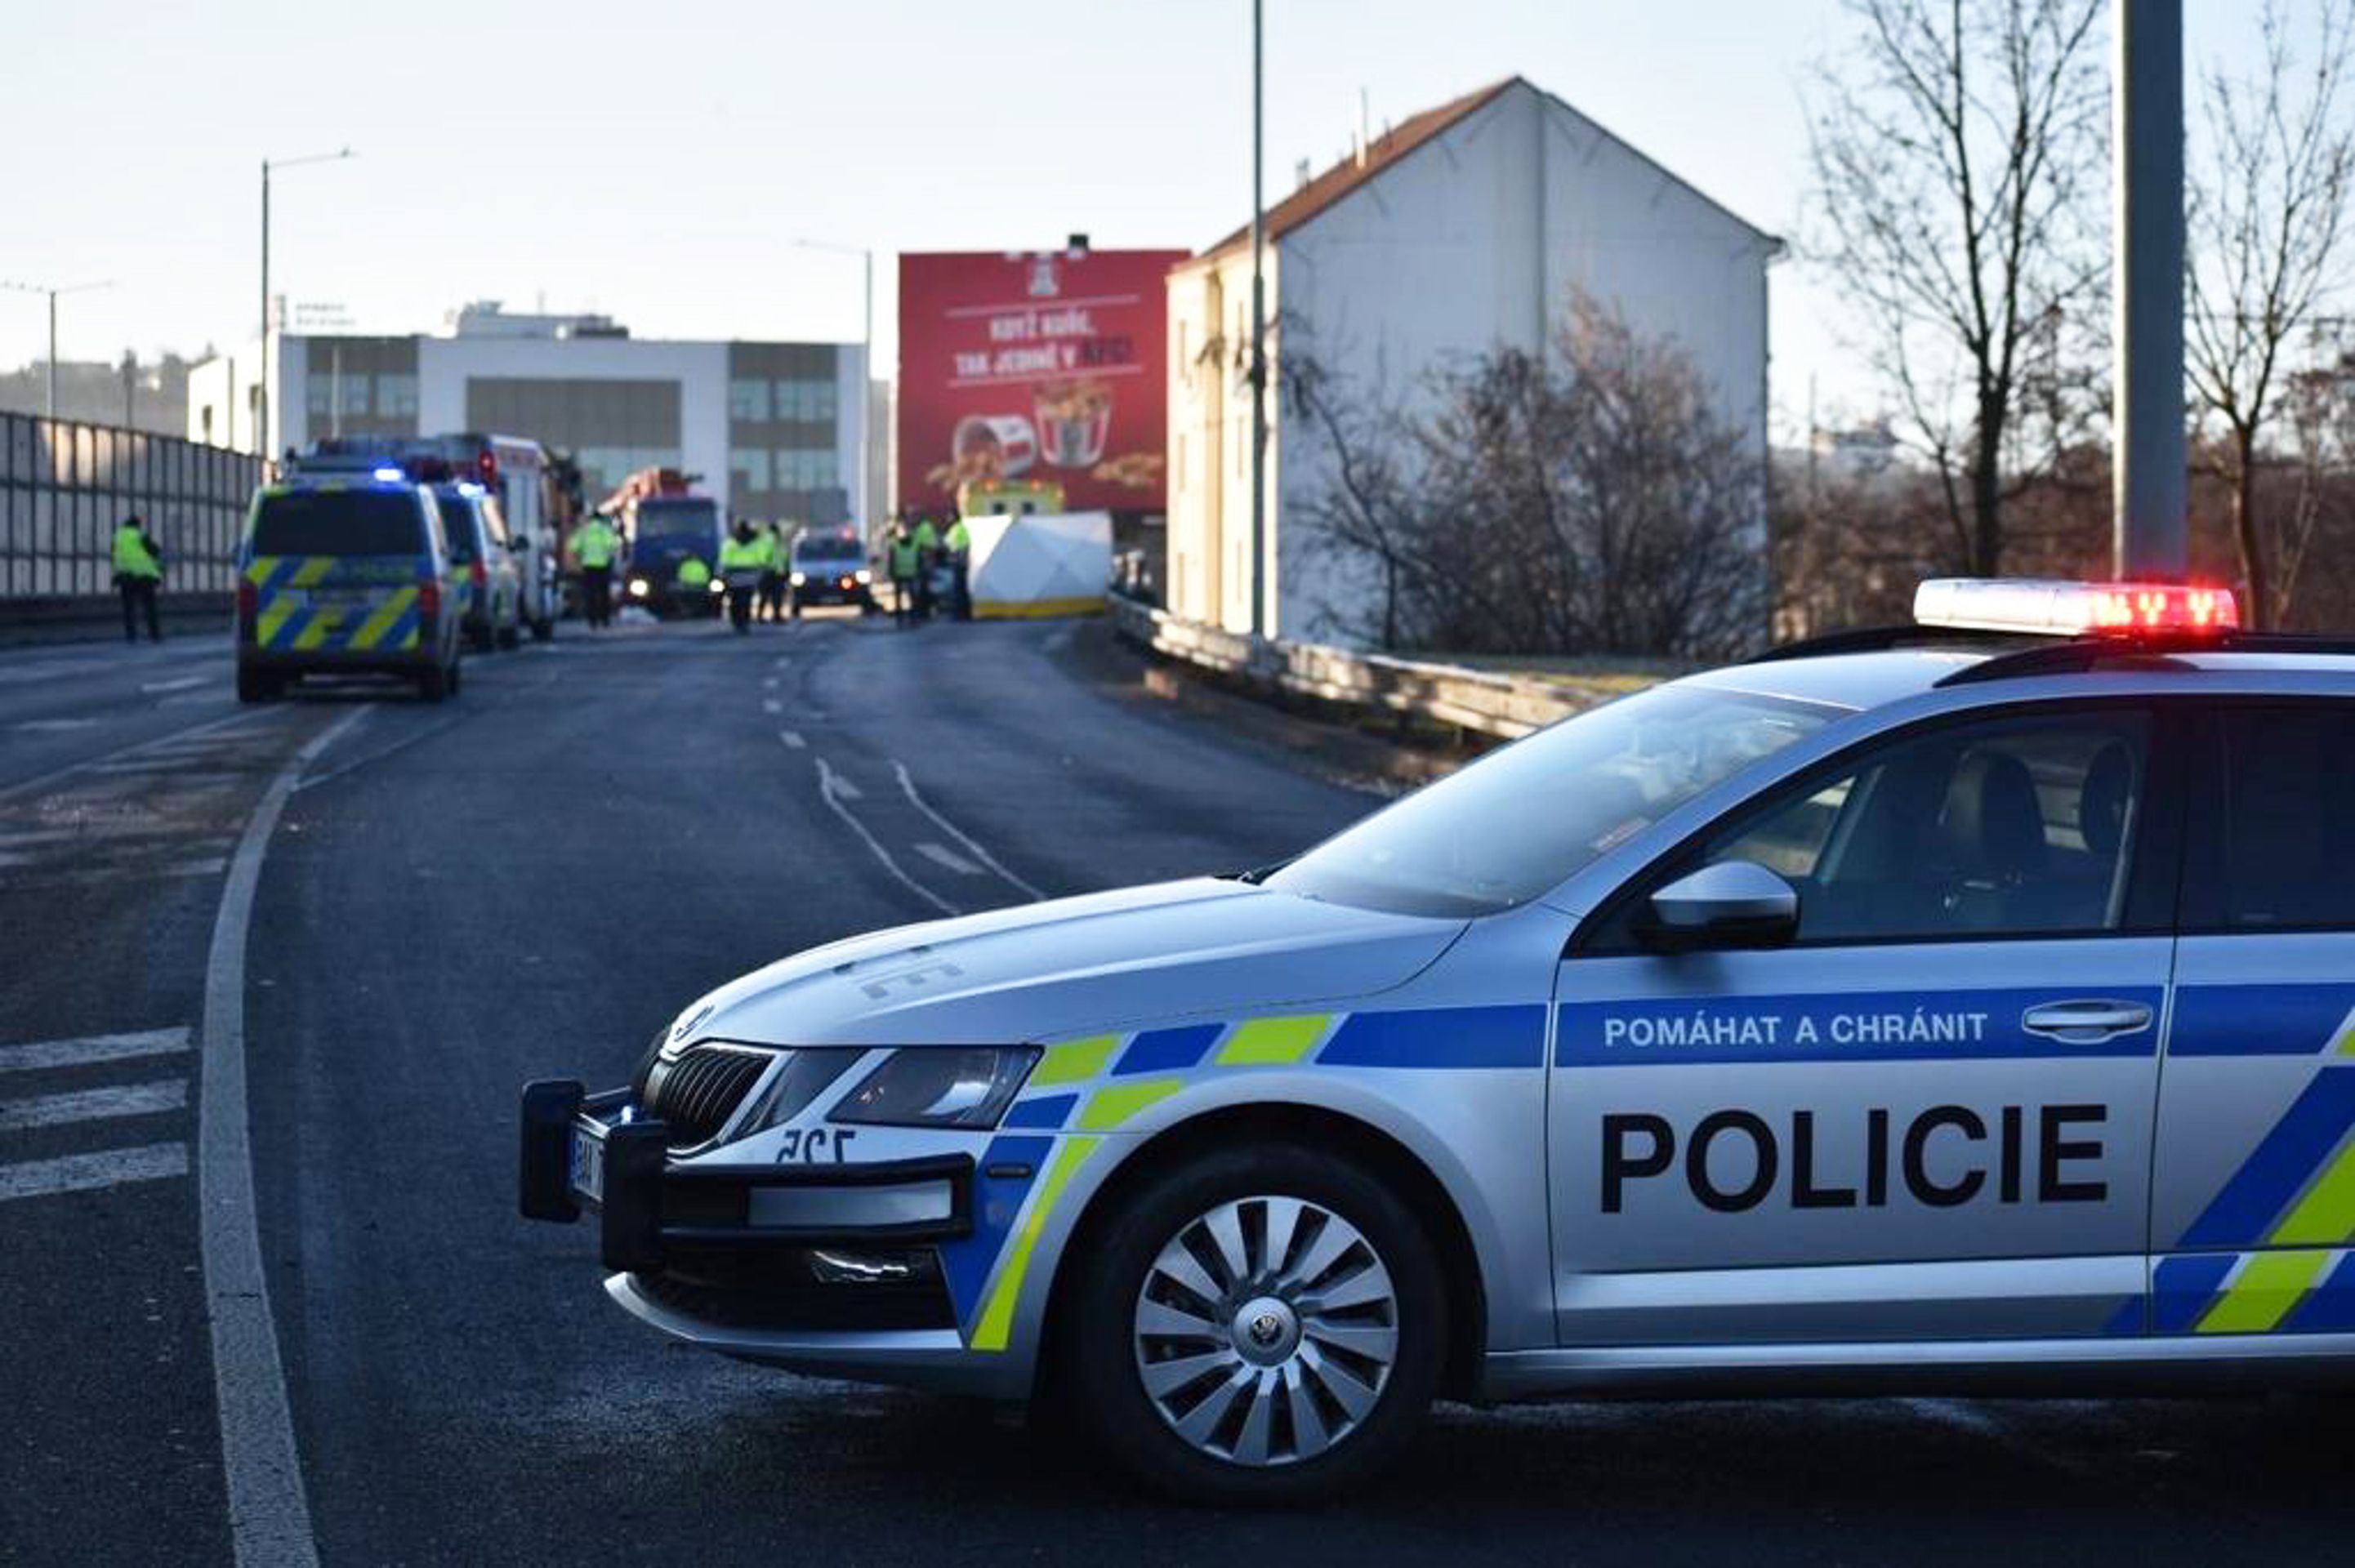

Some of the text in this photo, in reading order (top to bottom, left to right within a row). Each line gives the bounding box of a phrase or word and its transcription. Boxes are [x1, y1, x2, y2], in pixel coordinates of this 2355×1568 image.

[1604, 1006, 1988, 1047] POMÁHAT A CHRÁNIT
[1600, 1103, 2107, 1214] POLICIE
